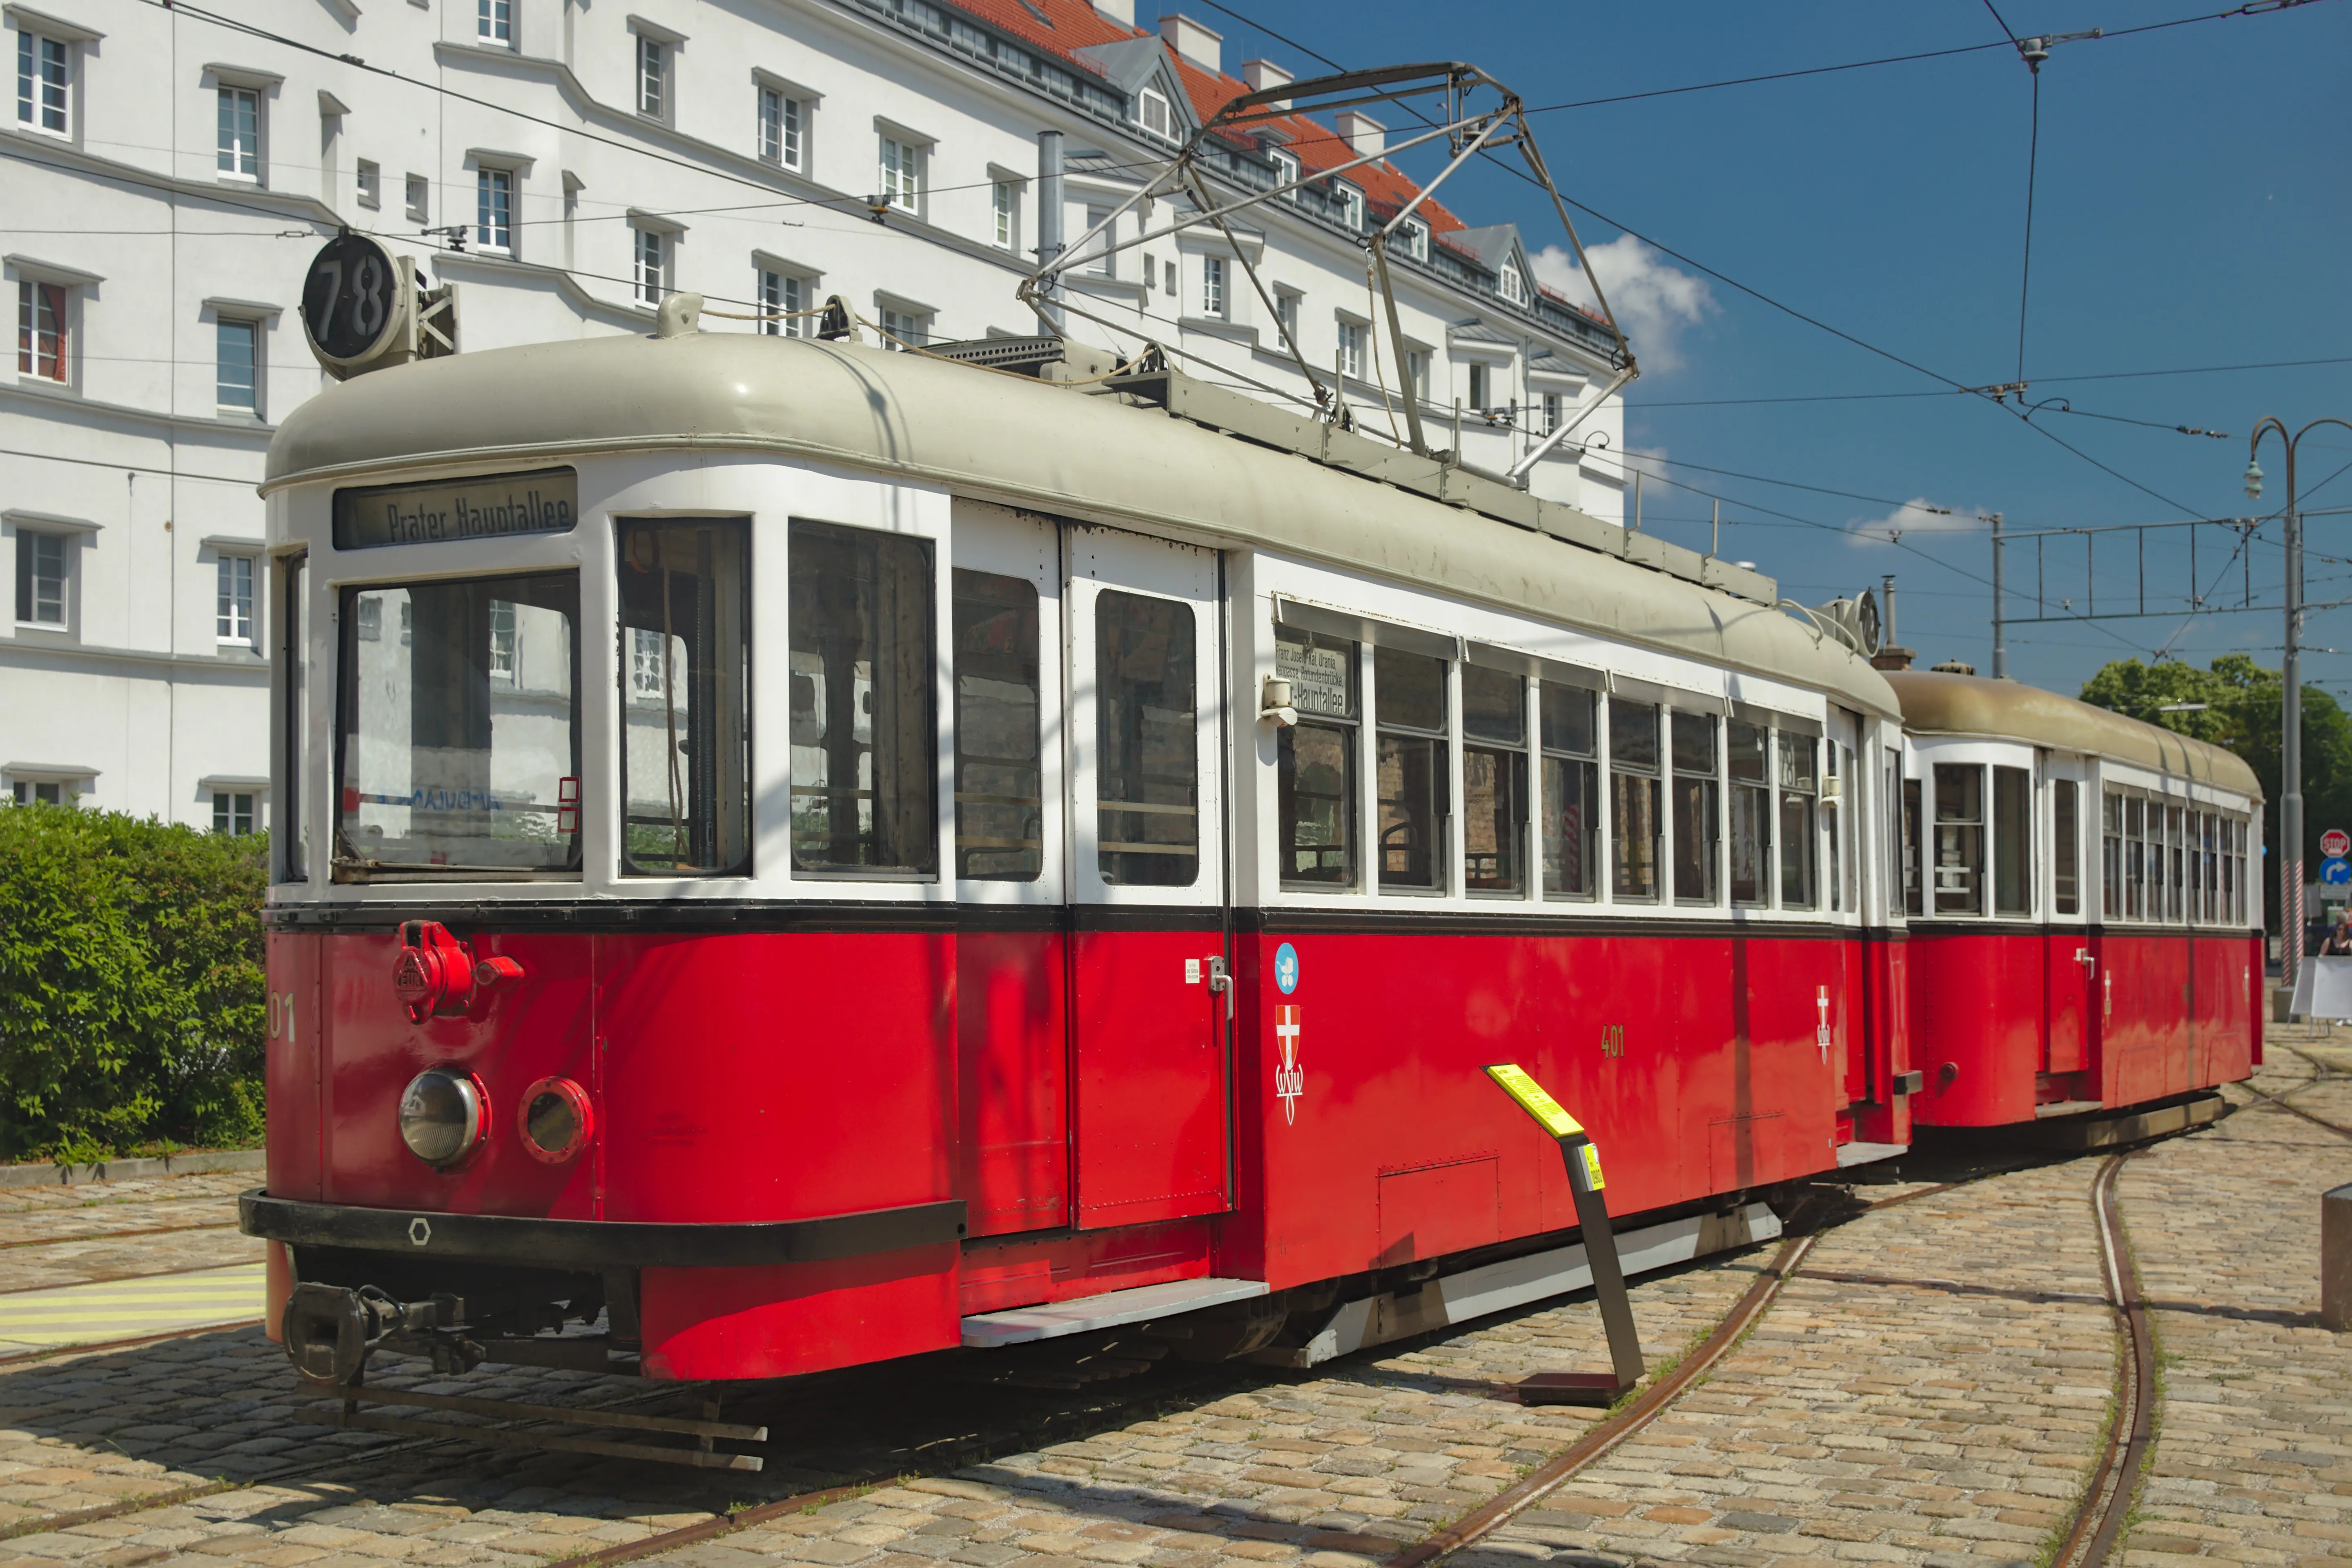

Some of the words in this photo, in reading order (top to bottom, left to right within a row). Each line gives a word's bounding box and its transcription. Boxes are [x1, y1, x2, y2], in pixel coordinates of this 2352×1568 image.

[318, 254, 383, 342] 78
[387, 502, 446, 543] Prater
[455, 490, 570, 537] Hauptallee
[1276, 644, 1289, 661] Franz
[1319, 653, 1336, 670] Urania,
[1301, 666, 1343, 688] Rotundenbrücke,
[1290, 682, 1343, 714] r-Hauptallee
[2323, 837, 2347, 849] STOP
[267, 991, 295, 1042] 01
[1601, 1024, 1624, 1059] 401
